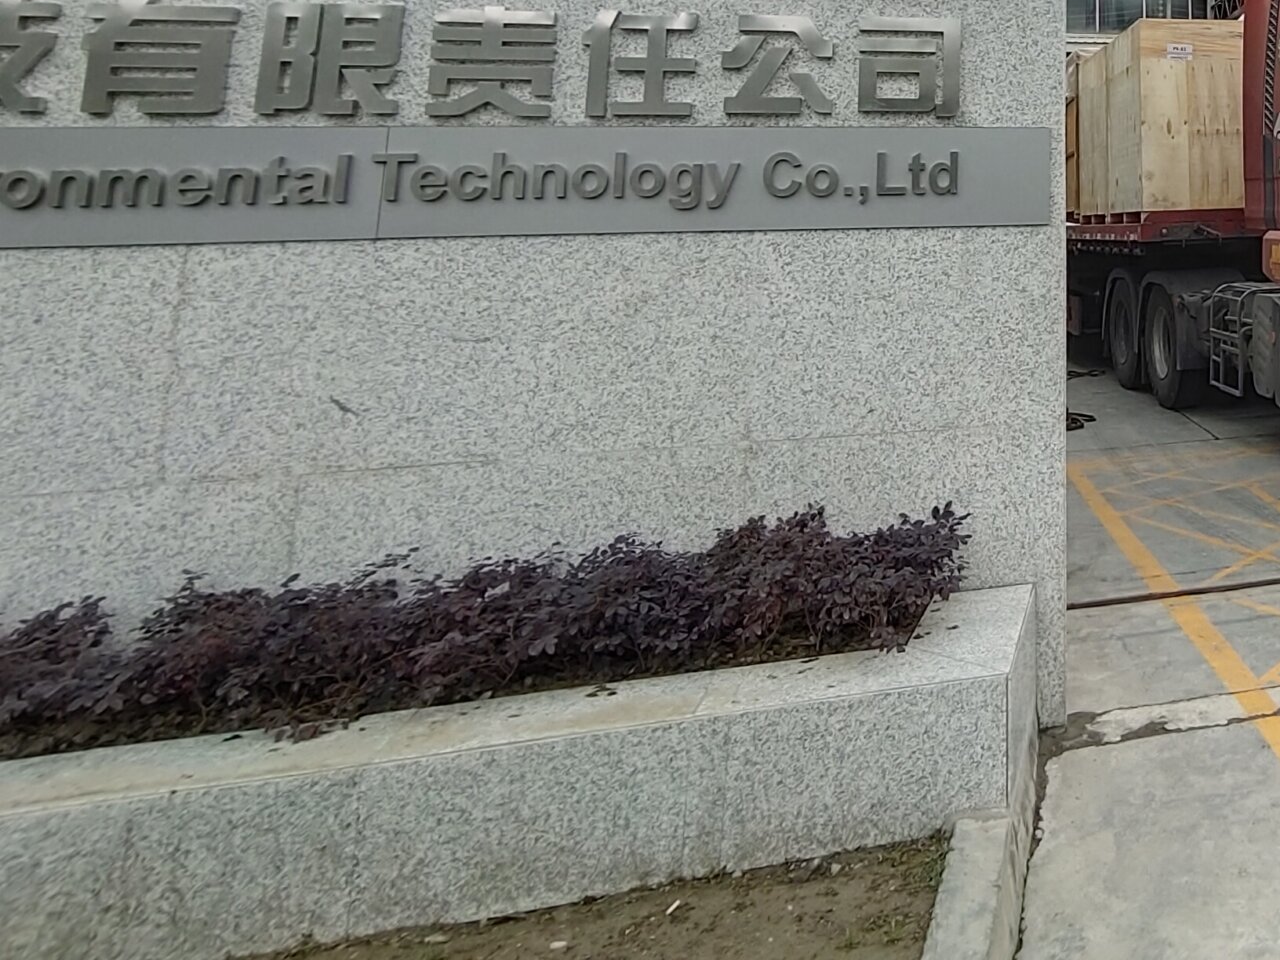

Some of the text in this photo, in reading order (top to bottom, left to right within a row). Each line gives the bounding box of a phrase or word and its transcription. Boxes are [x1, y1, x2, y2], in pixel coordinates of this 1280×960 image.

[0, 152, 961, 212] onmental Technology Co.,Ltd
